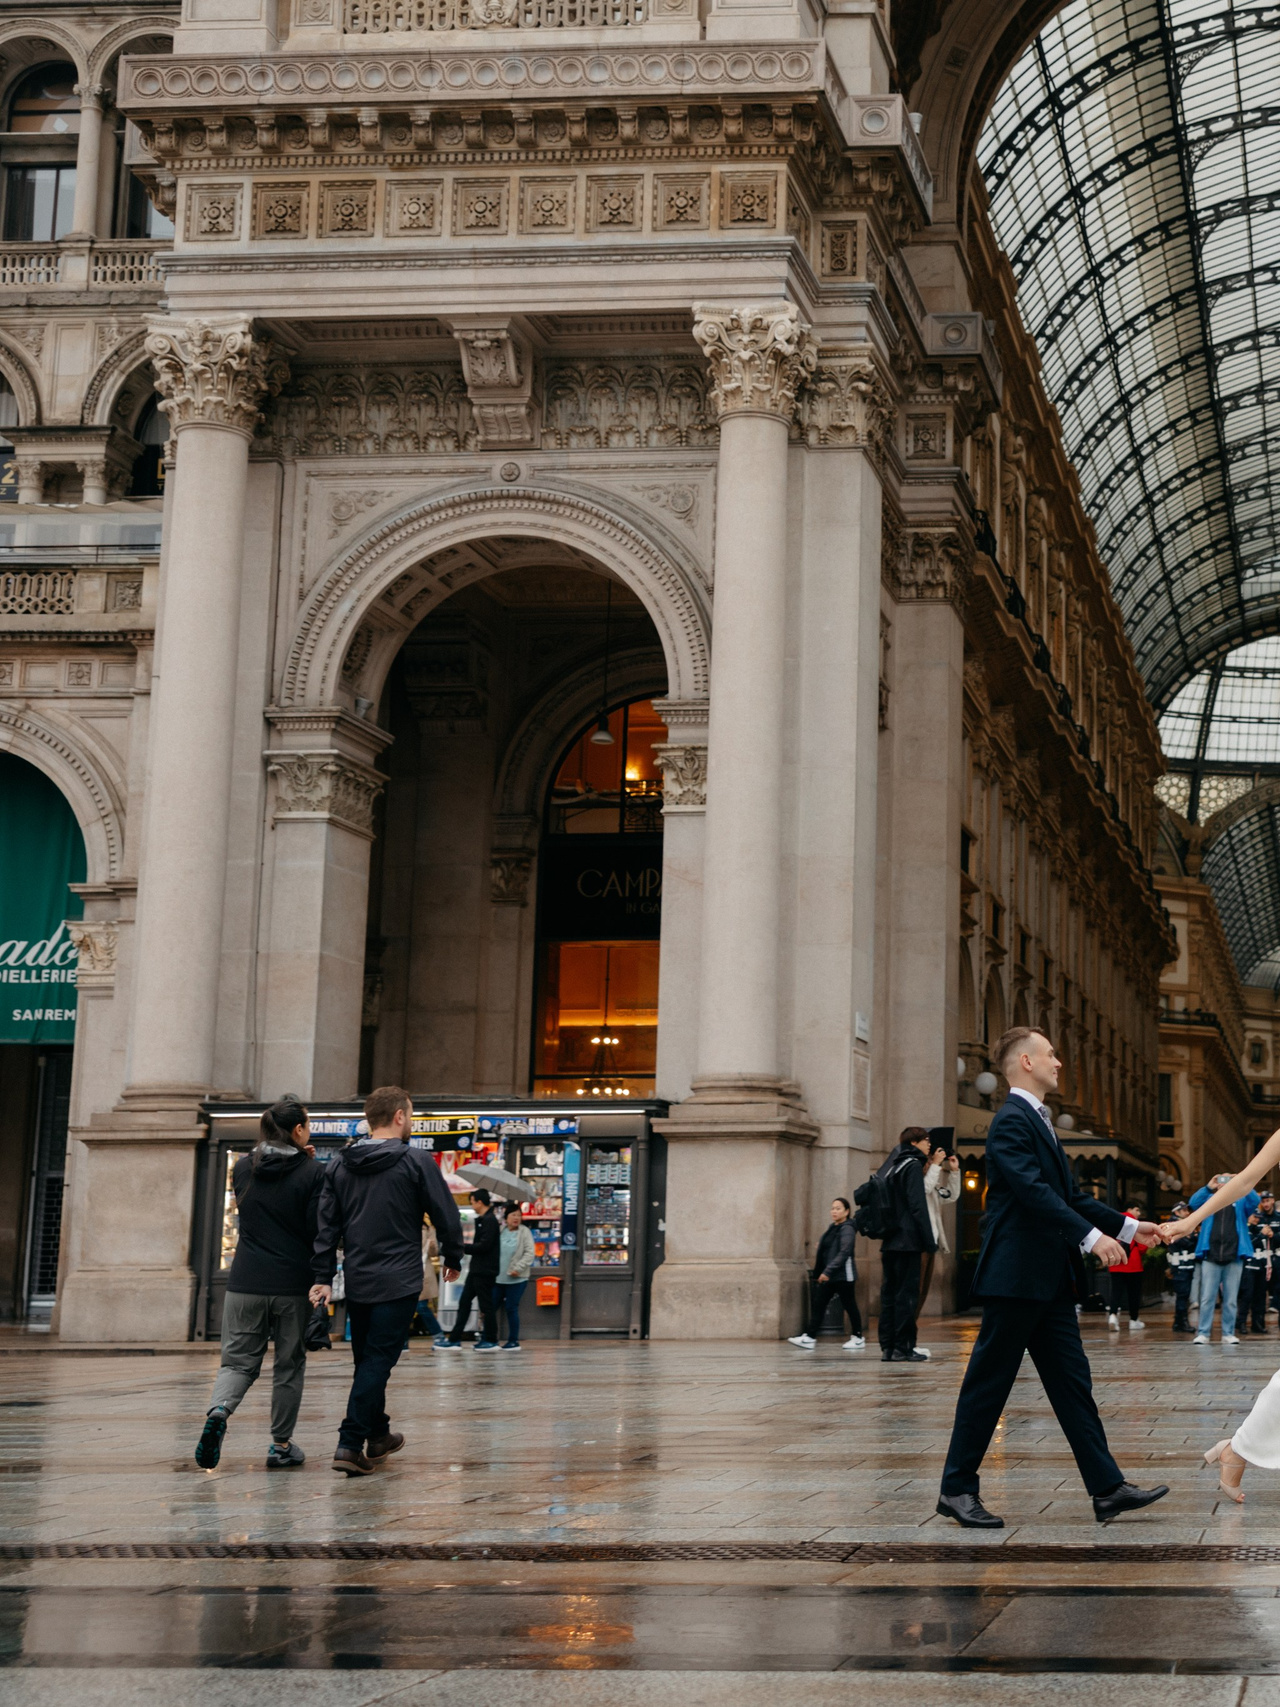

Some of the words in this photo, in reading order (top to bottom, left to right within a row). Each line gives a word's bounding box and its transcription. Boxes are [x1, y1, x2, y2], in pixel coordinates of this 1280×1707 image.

[640, 902, 661, 914] GA
[0, 969, 77, 984] IELLERIE
[12, 1008, 77, 1021] SANREM
[309, 1122, 324, 1133] RZA
